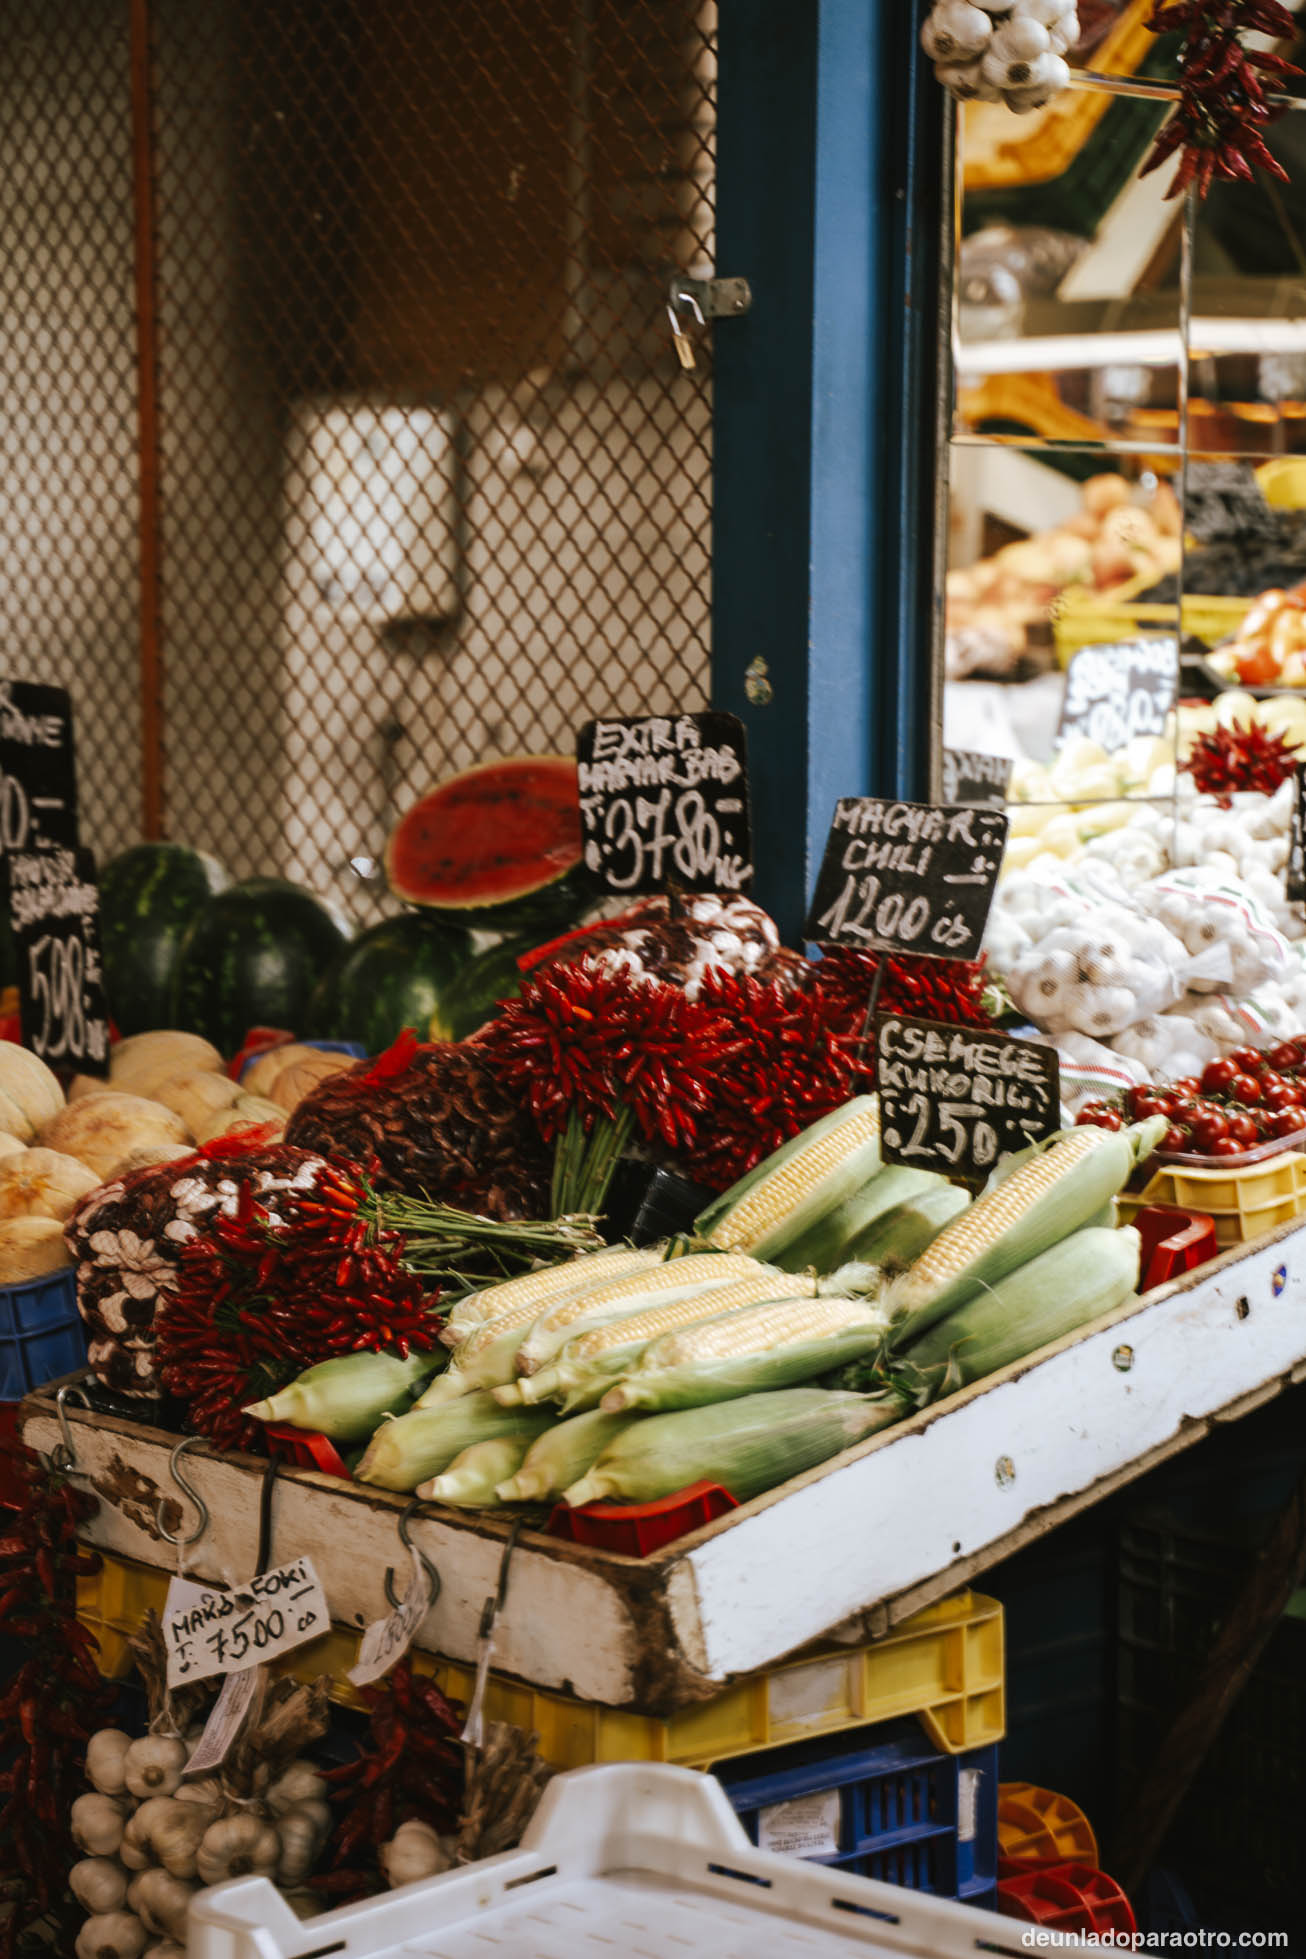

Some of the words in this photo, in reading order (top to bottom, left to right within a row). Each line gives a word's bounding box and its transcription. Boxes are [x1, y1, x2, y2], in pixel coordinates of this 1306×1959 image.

[592, 715, 701, 759] EXTRA
[832, 802, 978, 848] MAGYAR
[842, 839, 933, 877] CHILI
[817, 874, 931, 941] 1200
[878, 1020, 1049, 1084] CSEMEGE
[899, 1093, 999, 1166] 250
[206, 1610, 285, 1664] 7500
